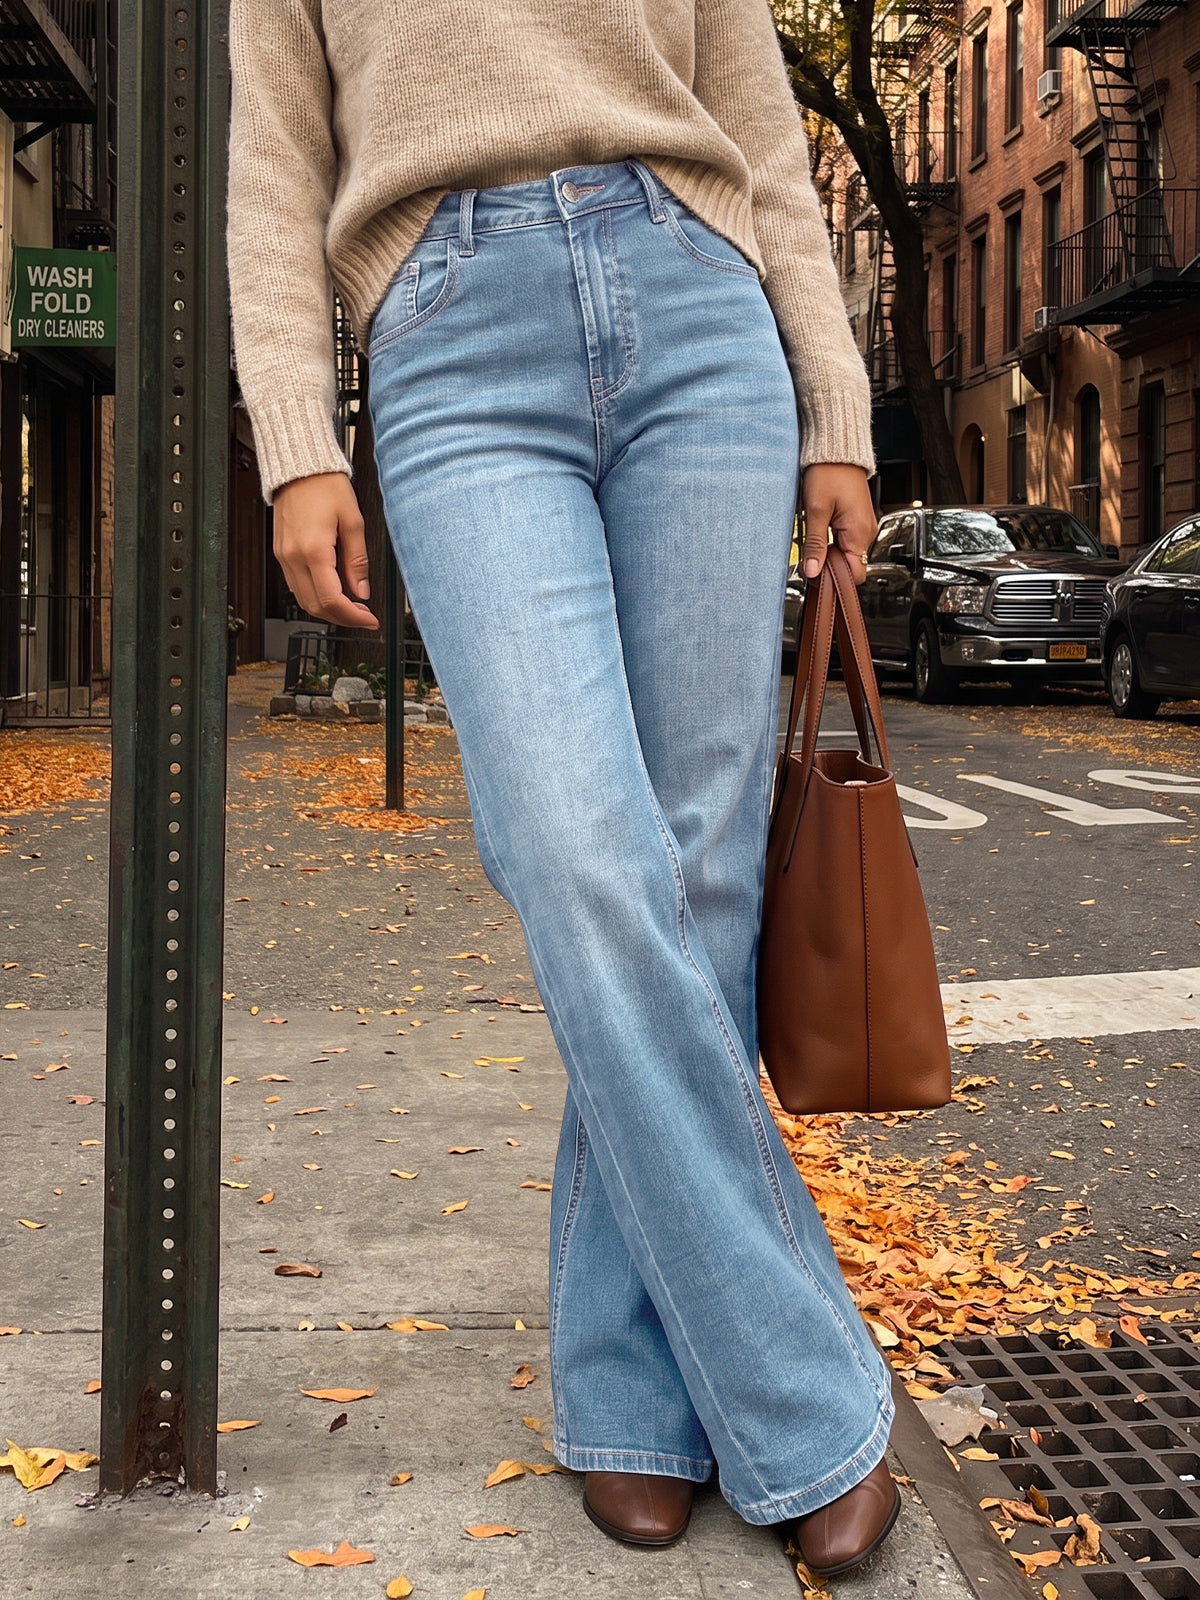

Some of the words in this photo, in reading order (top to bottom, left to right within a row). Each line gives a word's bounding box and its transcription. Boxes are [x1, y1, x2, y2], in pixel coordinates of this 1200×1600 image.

[27, 265, 93, 288] WASH
[31, 292, 91, 314] FOLD
[18, 319, 41, 338] DRY
[44, 319, 105, 339] CLEANERS
